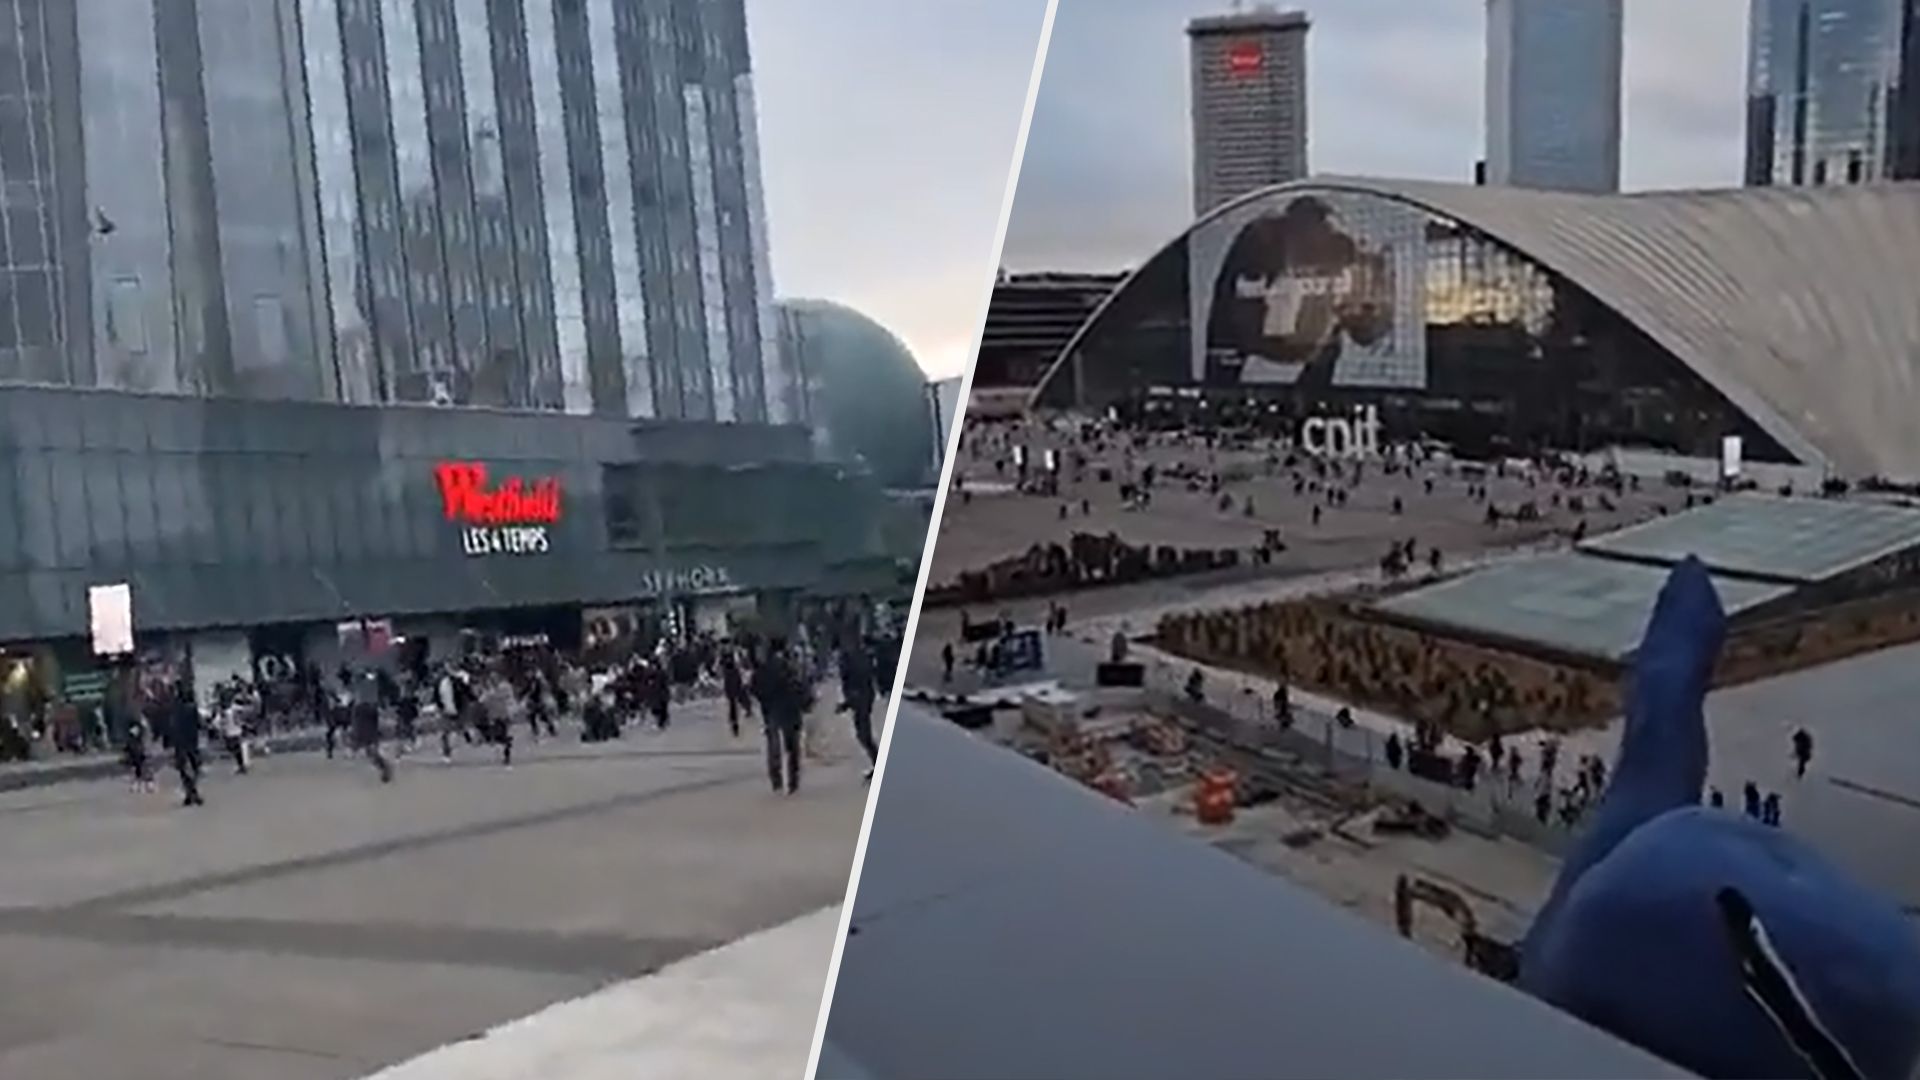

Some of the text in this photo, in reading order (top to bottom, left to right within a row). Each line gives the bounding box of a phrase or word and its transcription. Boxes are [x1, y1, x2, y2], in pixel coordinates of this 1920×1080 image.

[1302, 404, 1382, 459] cnit
[434, 461, 561, 524] Westfield
[462, 526, 549, 555] LES 4 TEMPS
